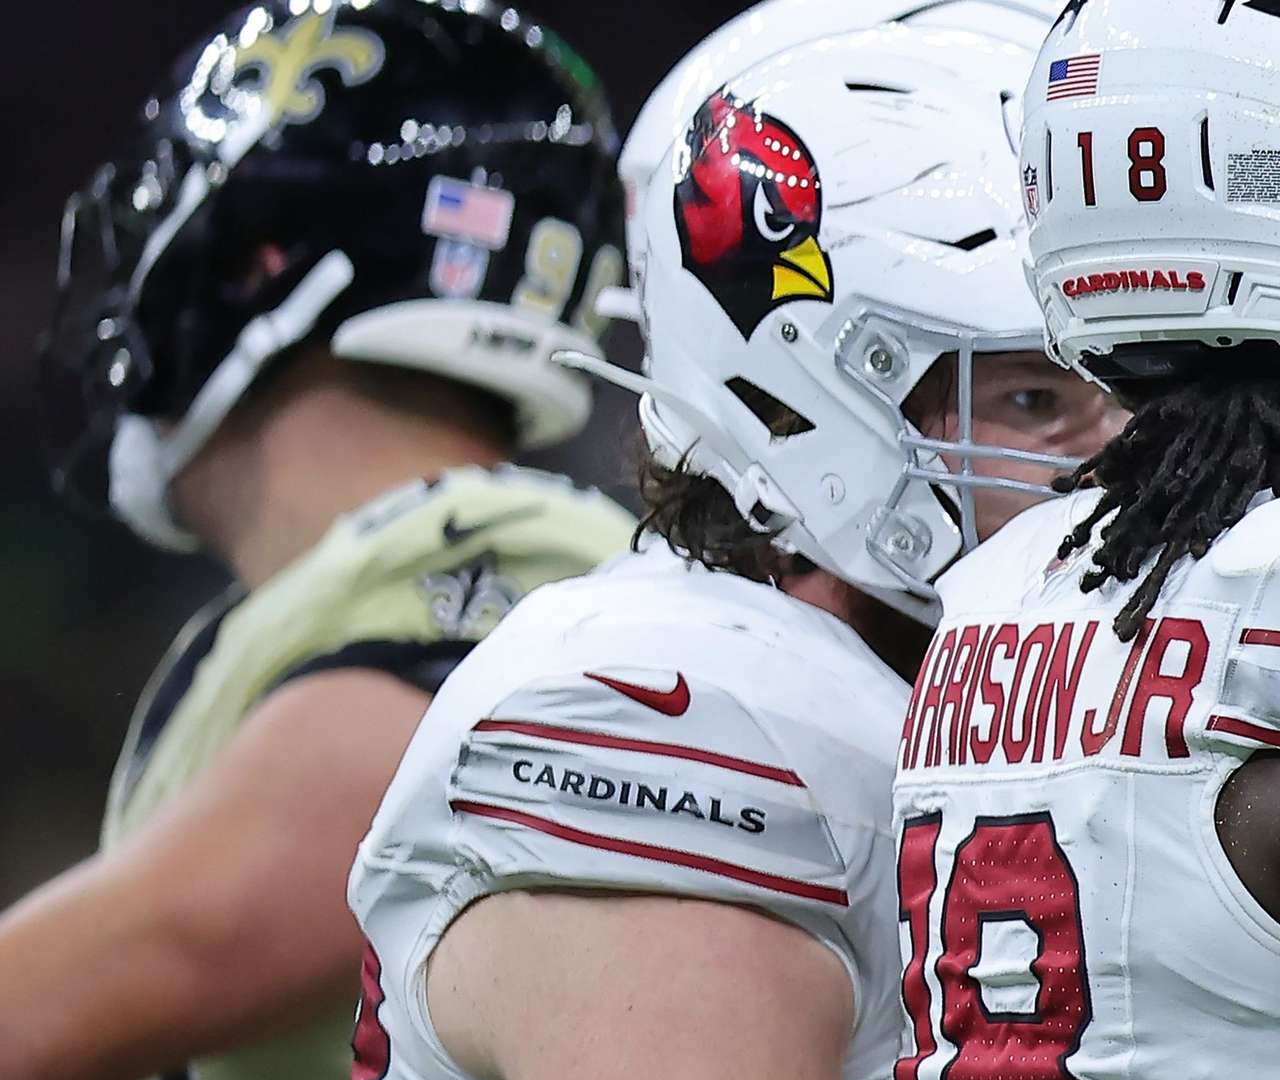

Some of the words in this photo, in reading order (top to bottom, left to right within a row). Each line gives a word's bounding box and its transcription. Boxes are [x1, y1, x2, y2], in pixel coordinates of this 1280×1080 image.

[1078, 127, 1167, 206] 18
[1062, 270, 1205, 299] CARDINALS
[1080, 616, 1210, 759] JR
[512, 759, 767, 834] CARDINALS
